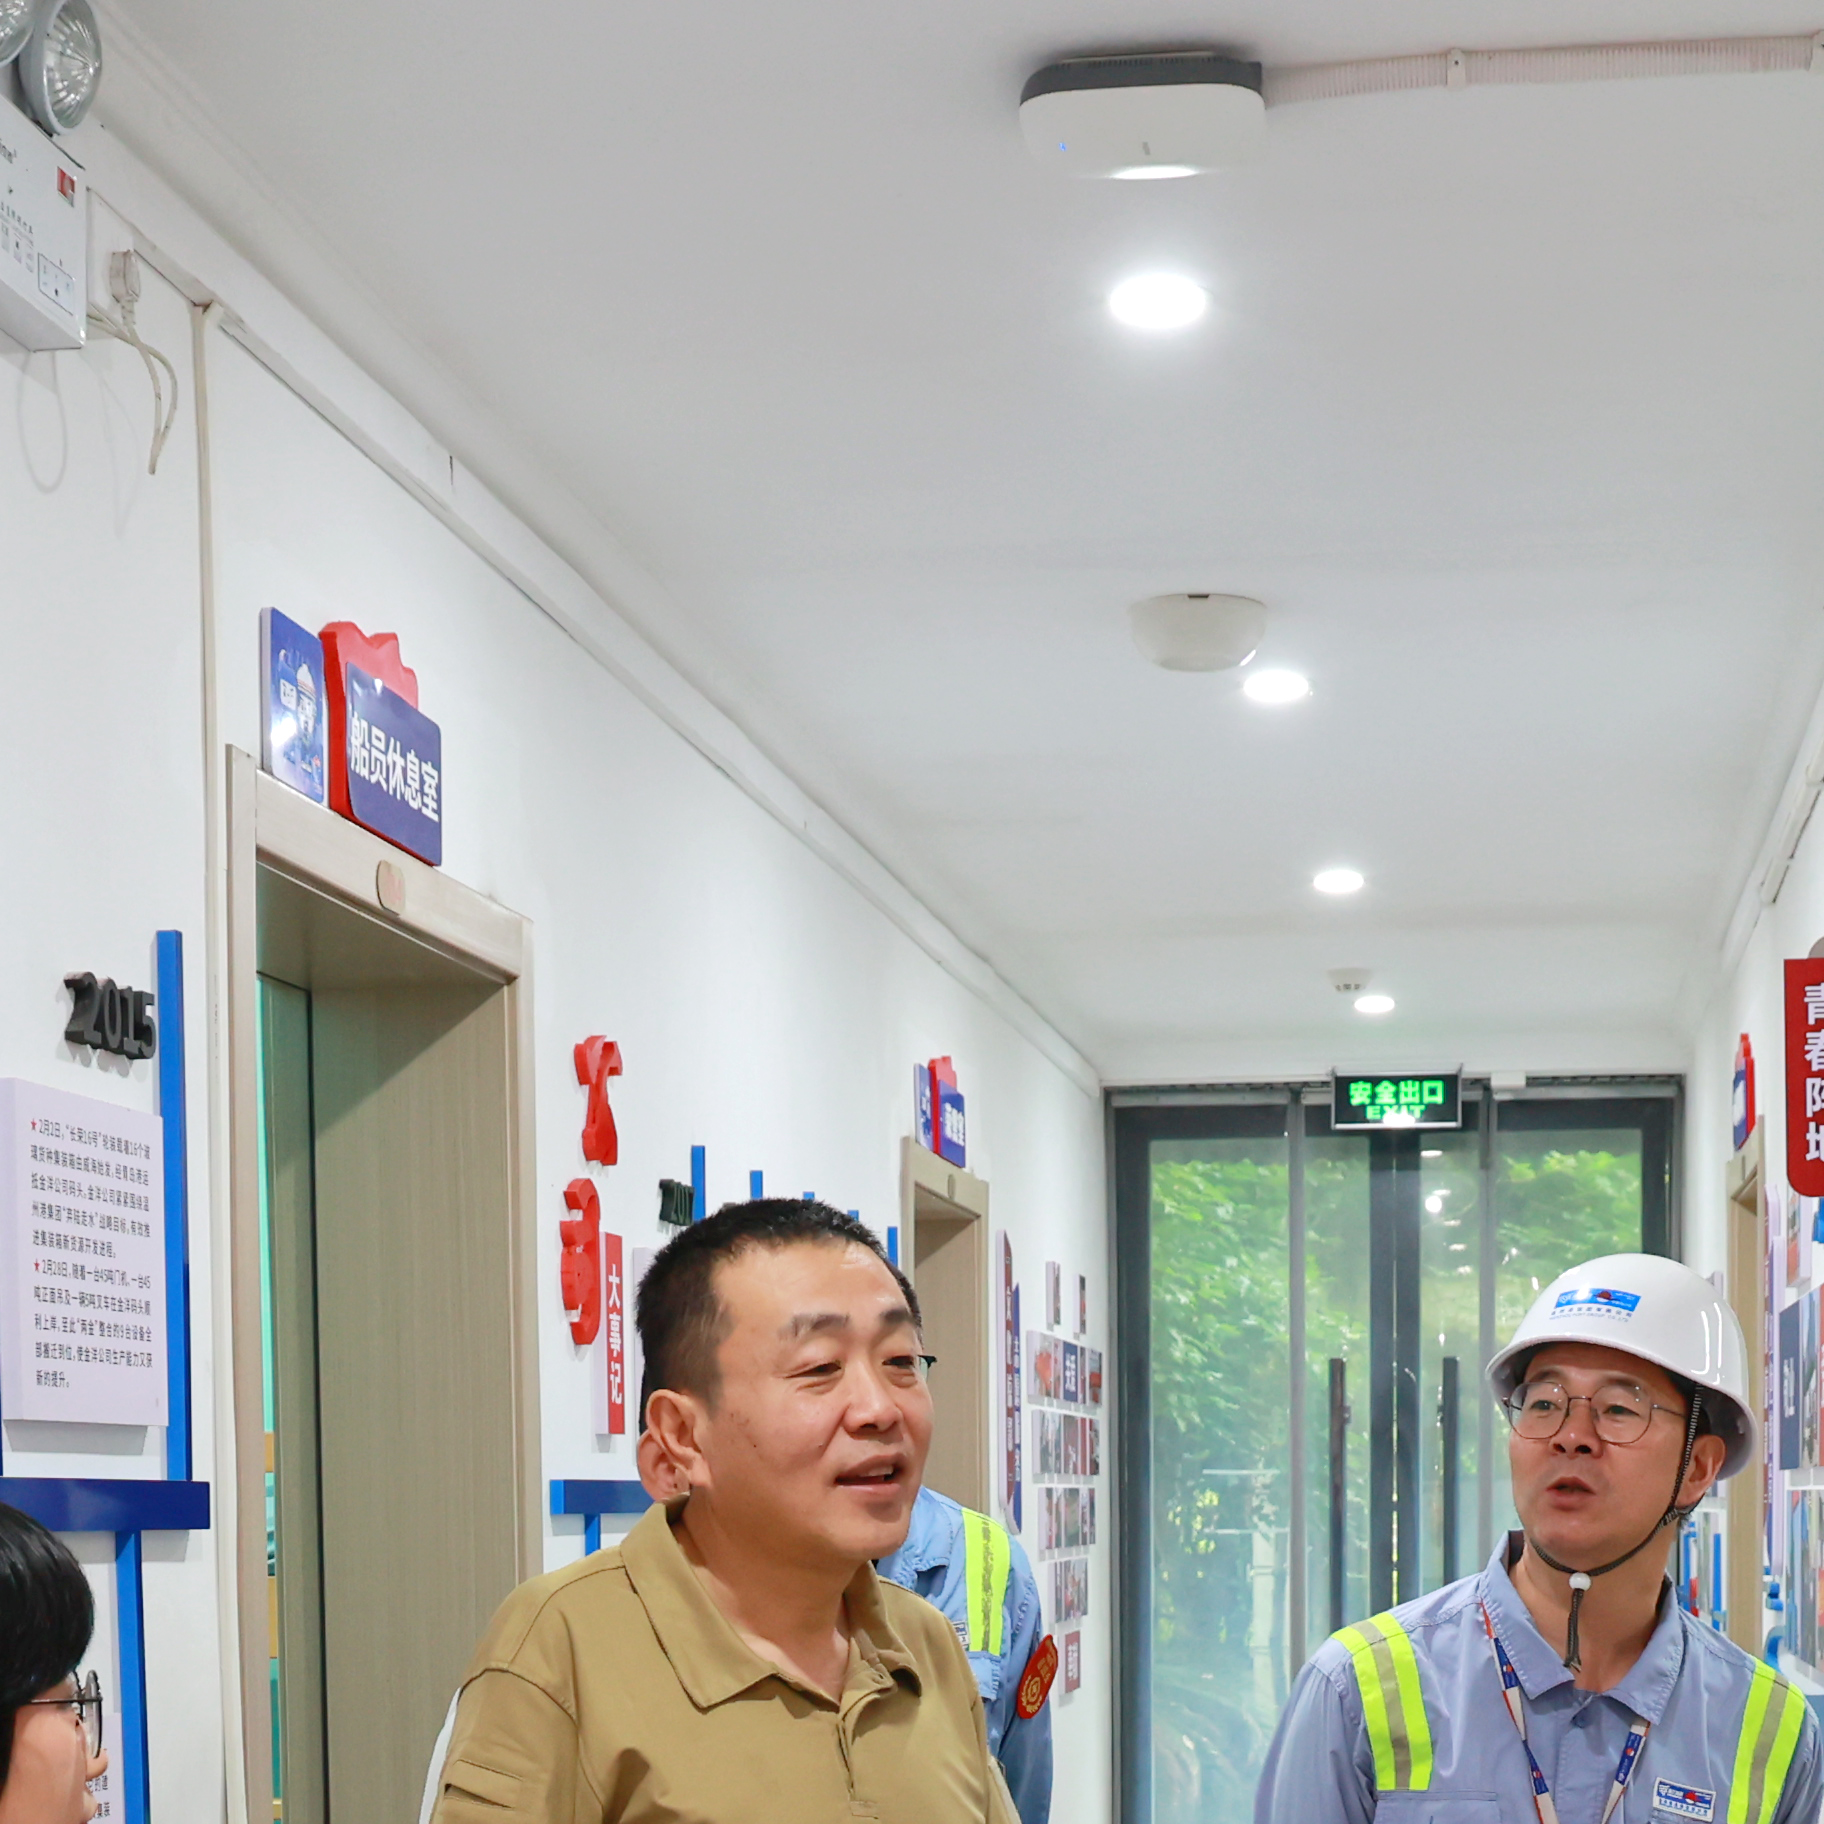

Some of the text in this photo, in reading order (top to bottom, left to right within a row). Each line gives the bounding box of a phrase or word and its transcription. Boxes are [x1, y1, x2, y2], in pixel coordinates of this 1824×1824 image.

[350, 711, 440, 822] 船员休息室
[63, 971, 156, 1060] 2015
[1349, 1080, 1444, 1106] 安全出口
[607, 1263, 624, 1405] 大事记
